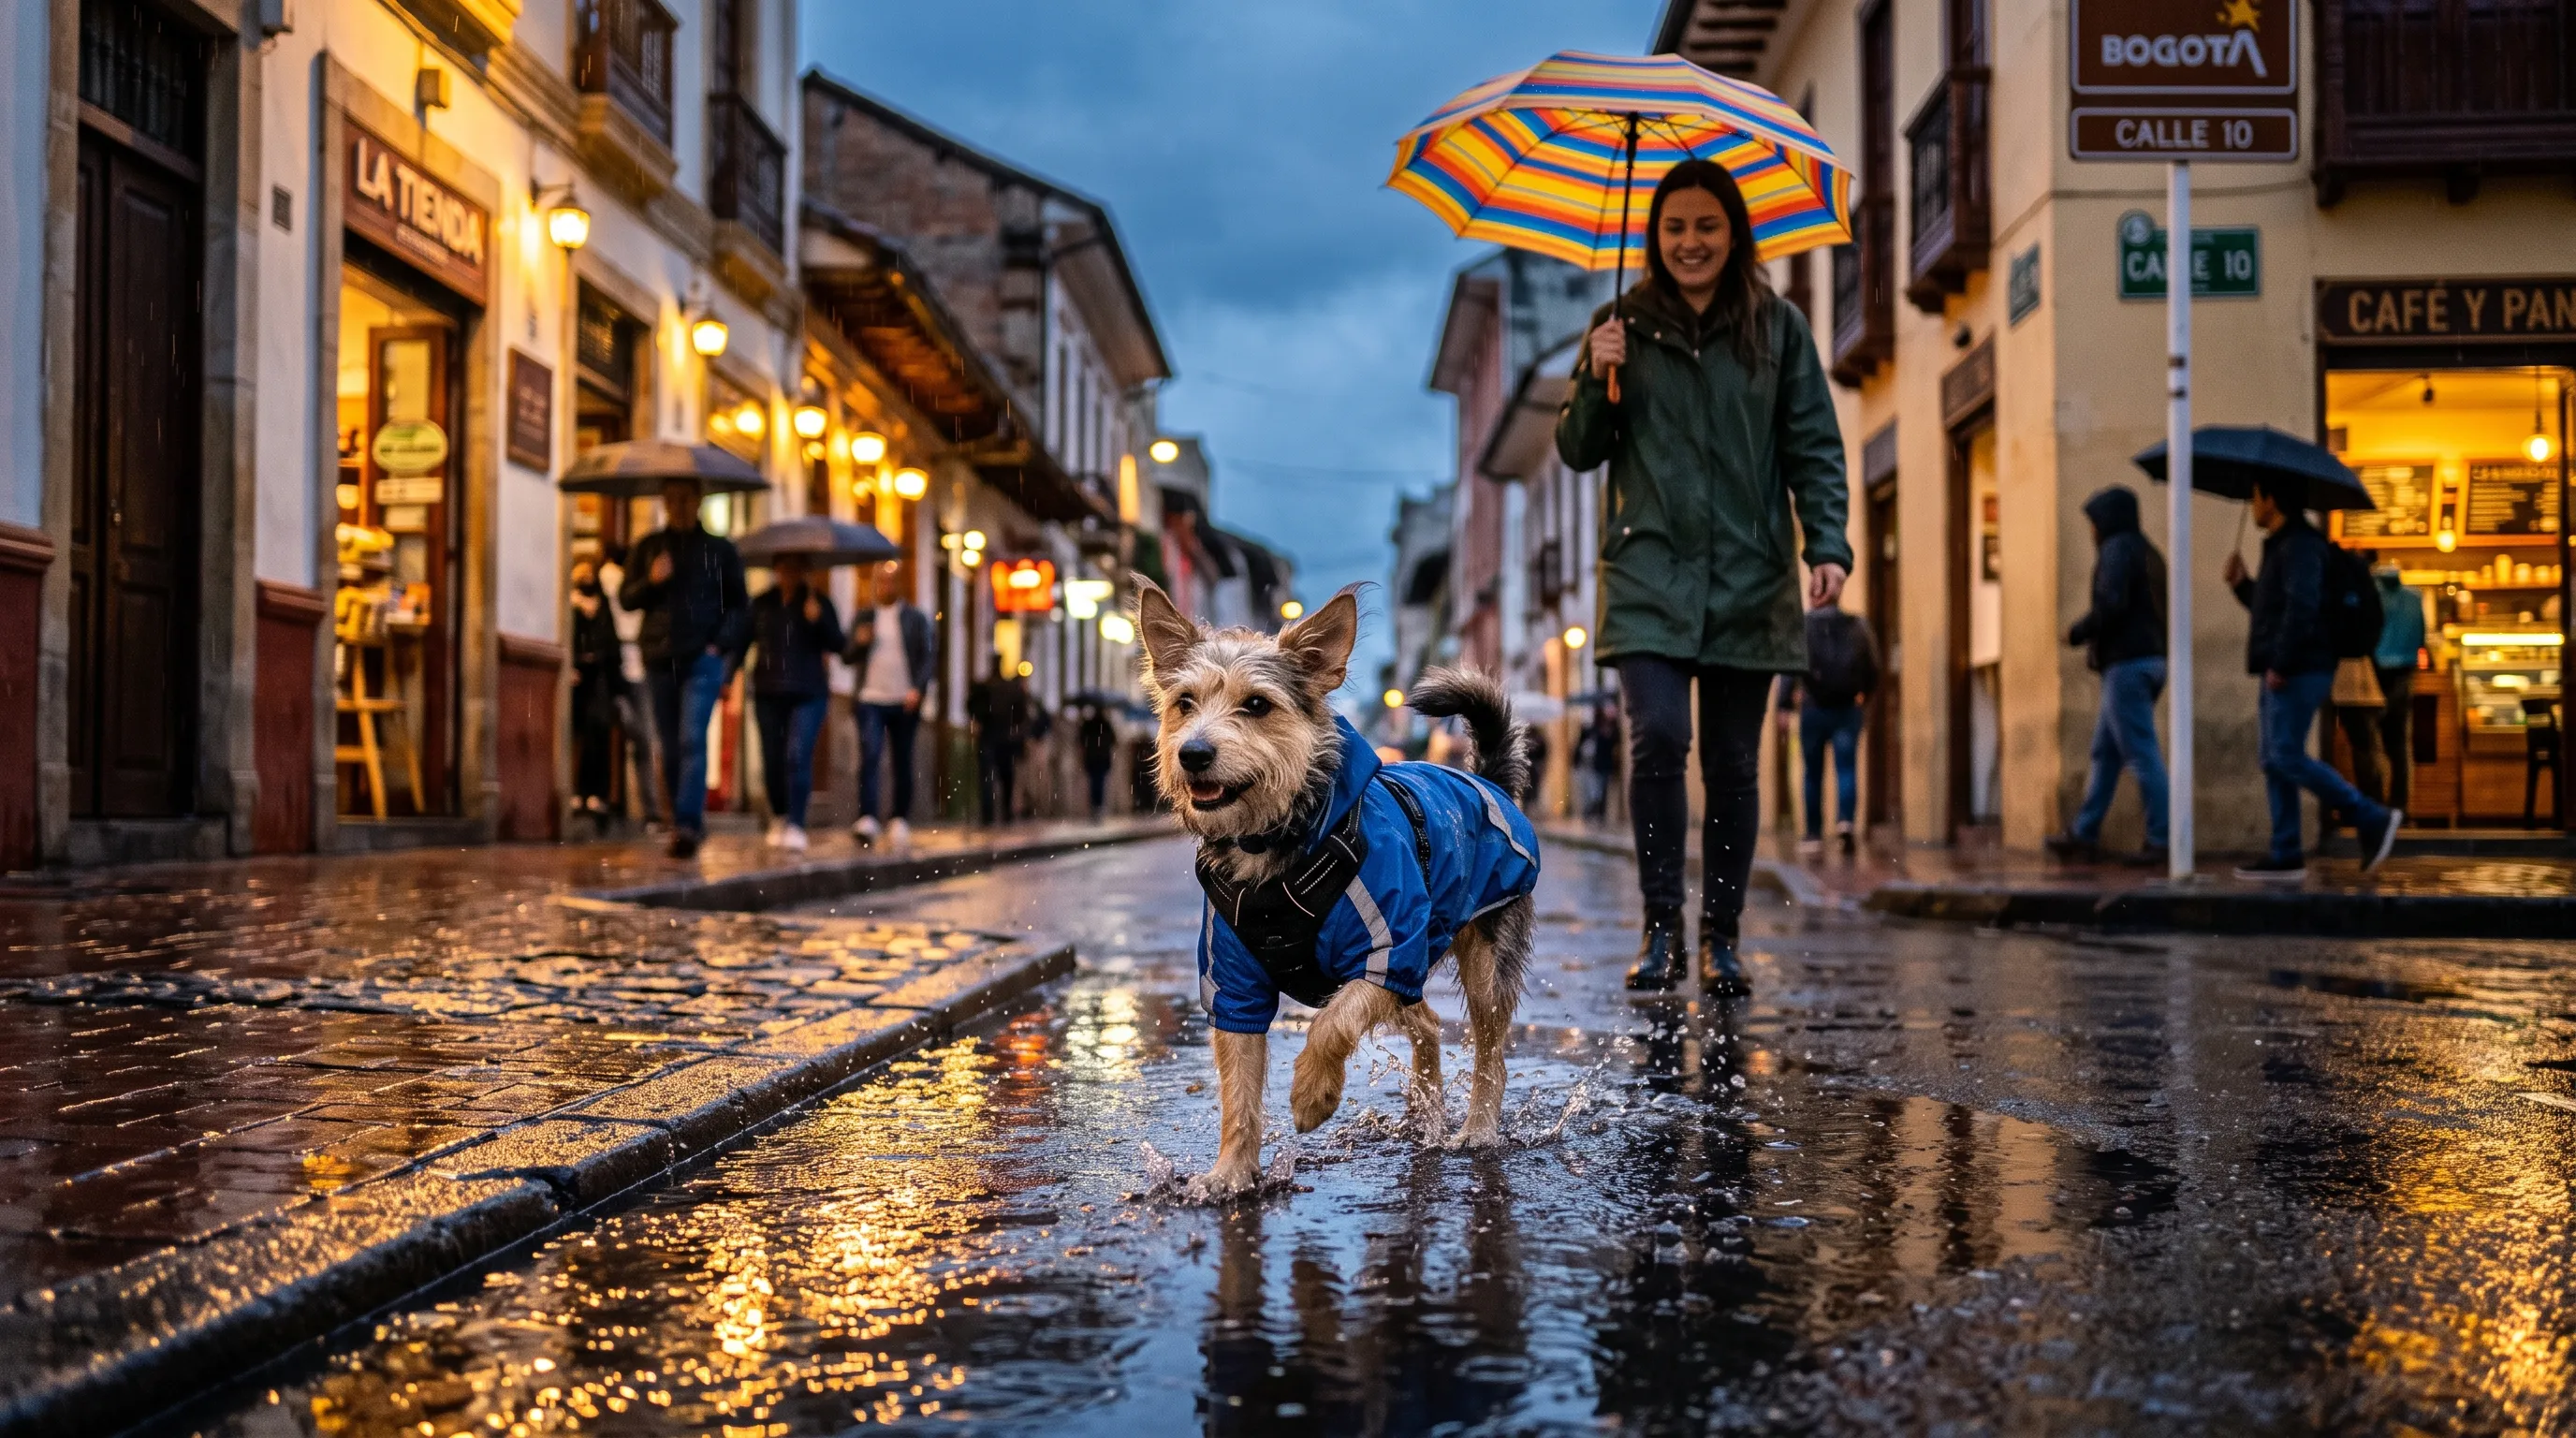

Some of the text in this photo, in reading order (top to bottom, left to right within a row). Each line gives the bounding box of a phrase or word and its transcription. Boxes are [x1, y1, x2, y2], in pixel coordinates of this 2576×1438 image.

[2115, 119, 2254, 149] CALLE 10
[358, 137, 394, 212] LA
[395, 162, 484, 265] TIENDA
[2127, 249, 2253, 282] CAE 10
[2462, 288, 2488, 331] Y
